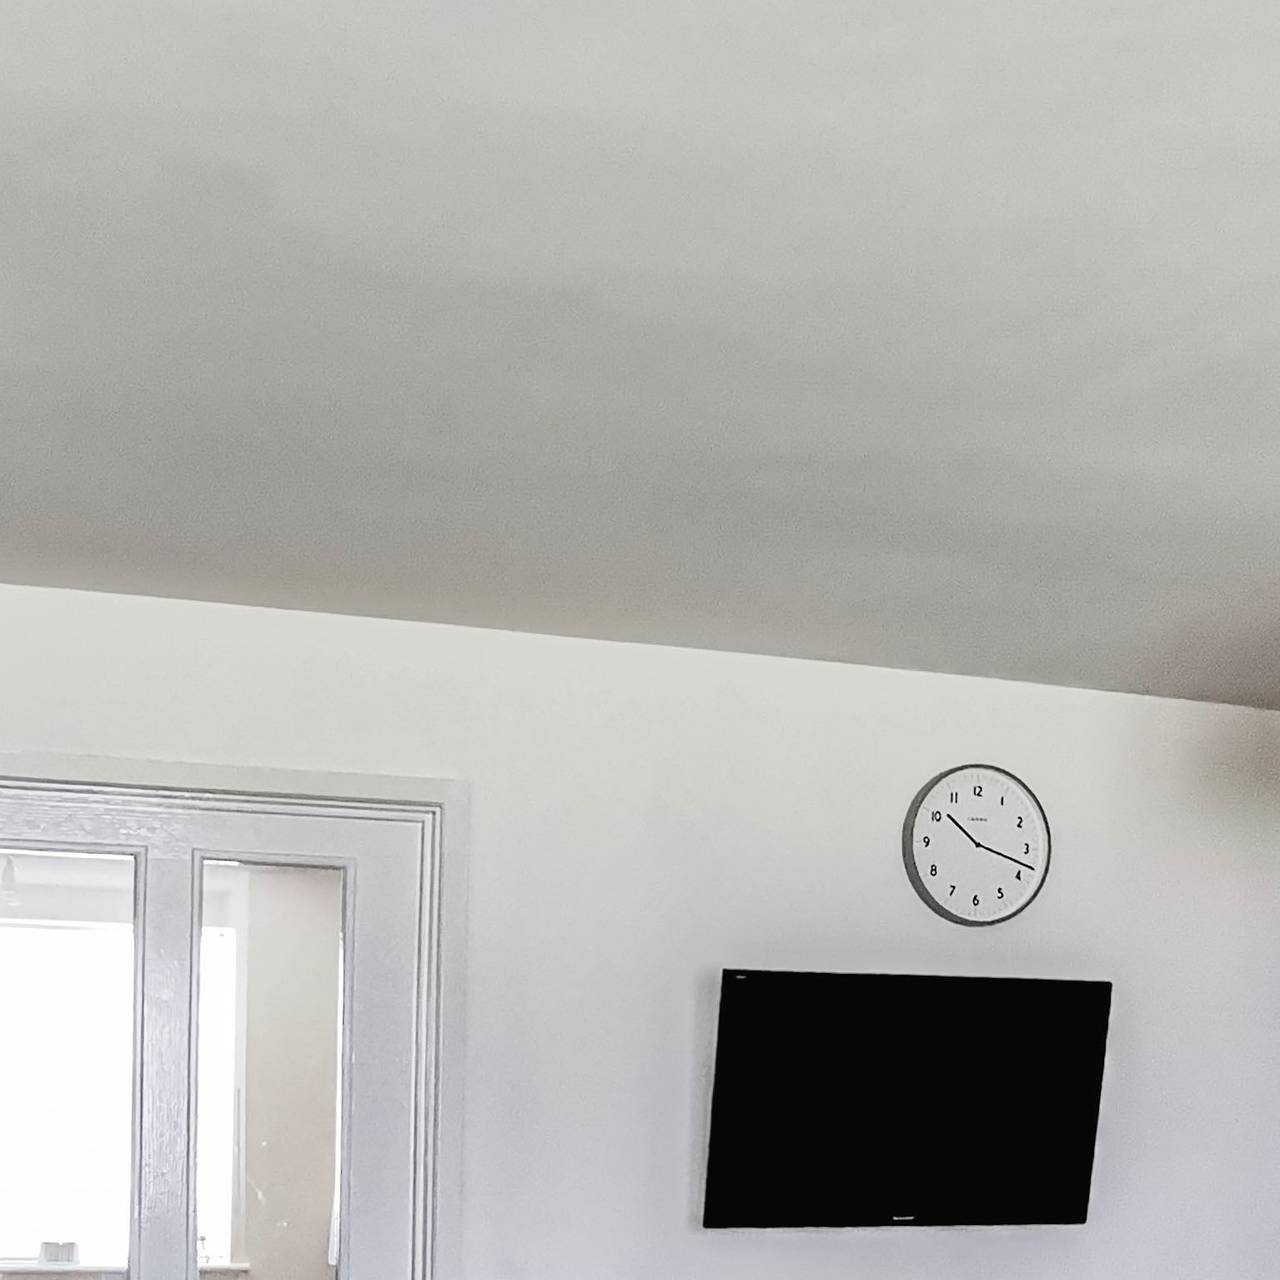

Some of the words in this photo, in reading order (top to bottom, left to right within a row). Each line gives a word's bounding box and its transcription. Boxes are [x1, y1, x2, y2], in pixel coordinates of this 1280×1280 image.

[949, 791, 959, 804] 11
[973, 785, 983, 798] 12
[931, 810, 942, 823] 10
[1016, 815, 1024, 829] 2
[922, 835, 931, 848] 9
[1023, 842, 1030, 856] 3
[929, 863, 938, 878] 8
[1014, 869, 1022, 882] 4
[949, 884, 957, 897] 7
[996, 887, 1005, 900] 5
[971, 894, 980, 907] 6
